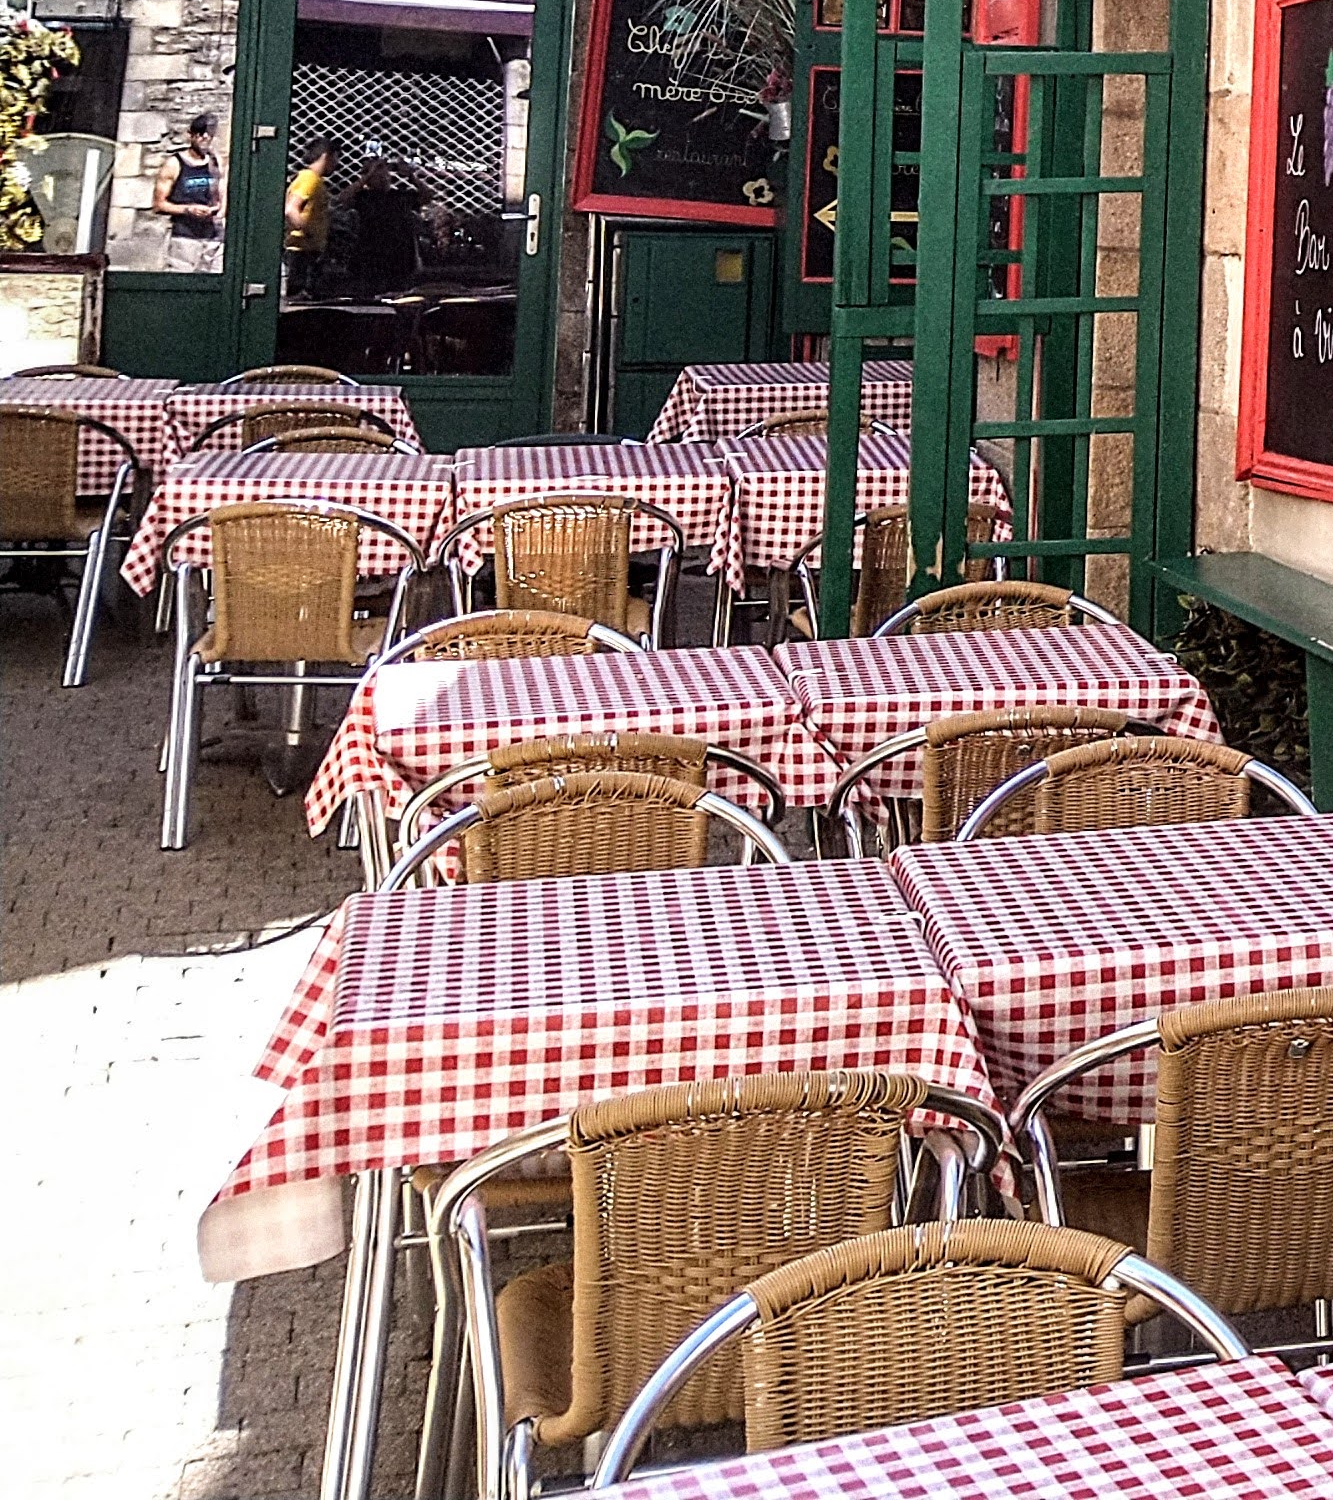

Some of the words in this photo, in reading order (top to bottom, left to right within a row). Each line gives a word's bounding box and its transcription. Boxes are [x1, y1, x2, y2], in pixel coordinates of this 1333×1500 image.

[633, 77, 702, 102] mère
[1287, 113, 1305, 176] Le
[1295, 199, 1329, 275] Bar
[1293, 299, 1304, 358] à
